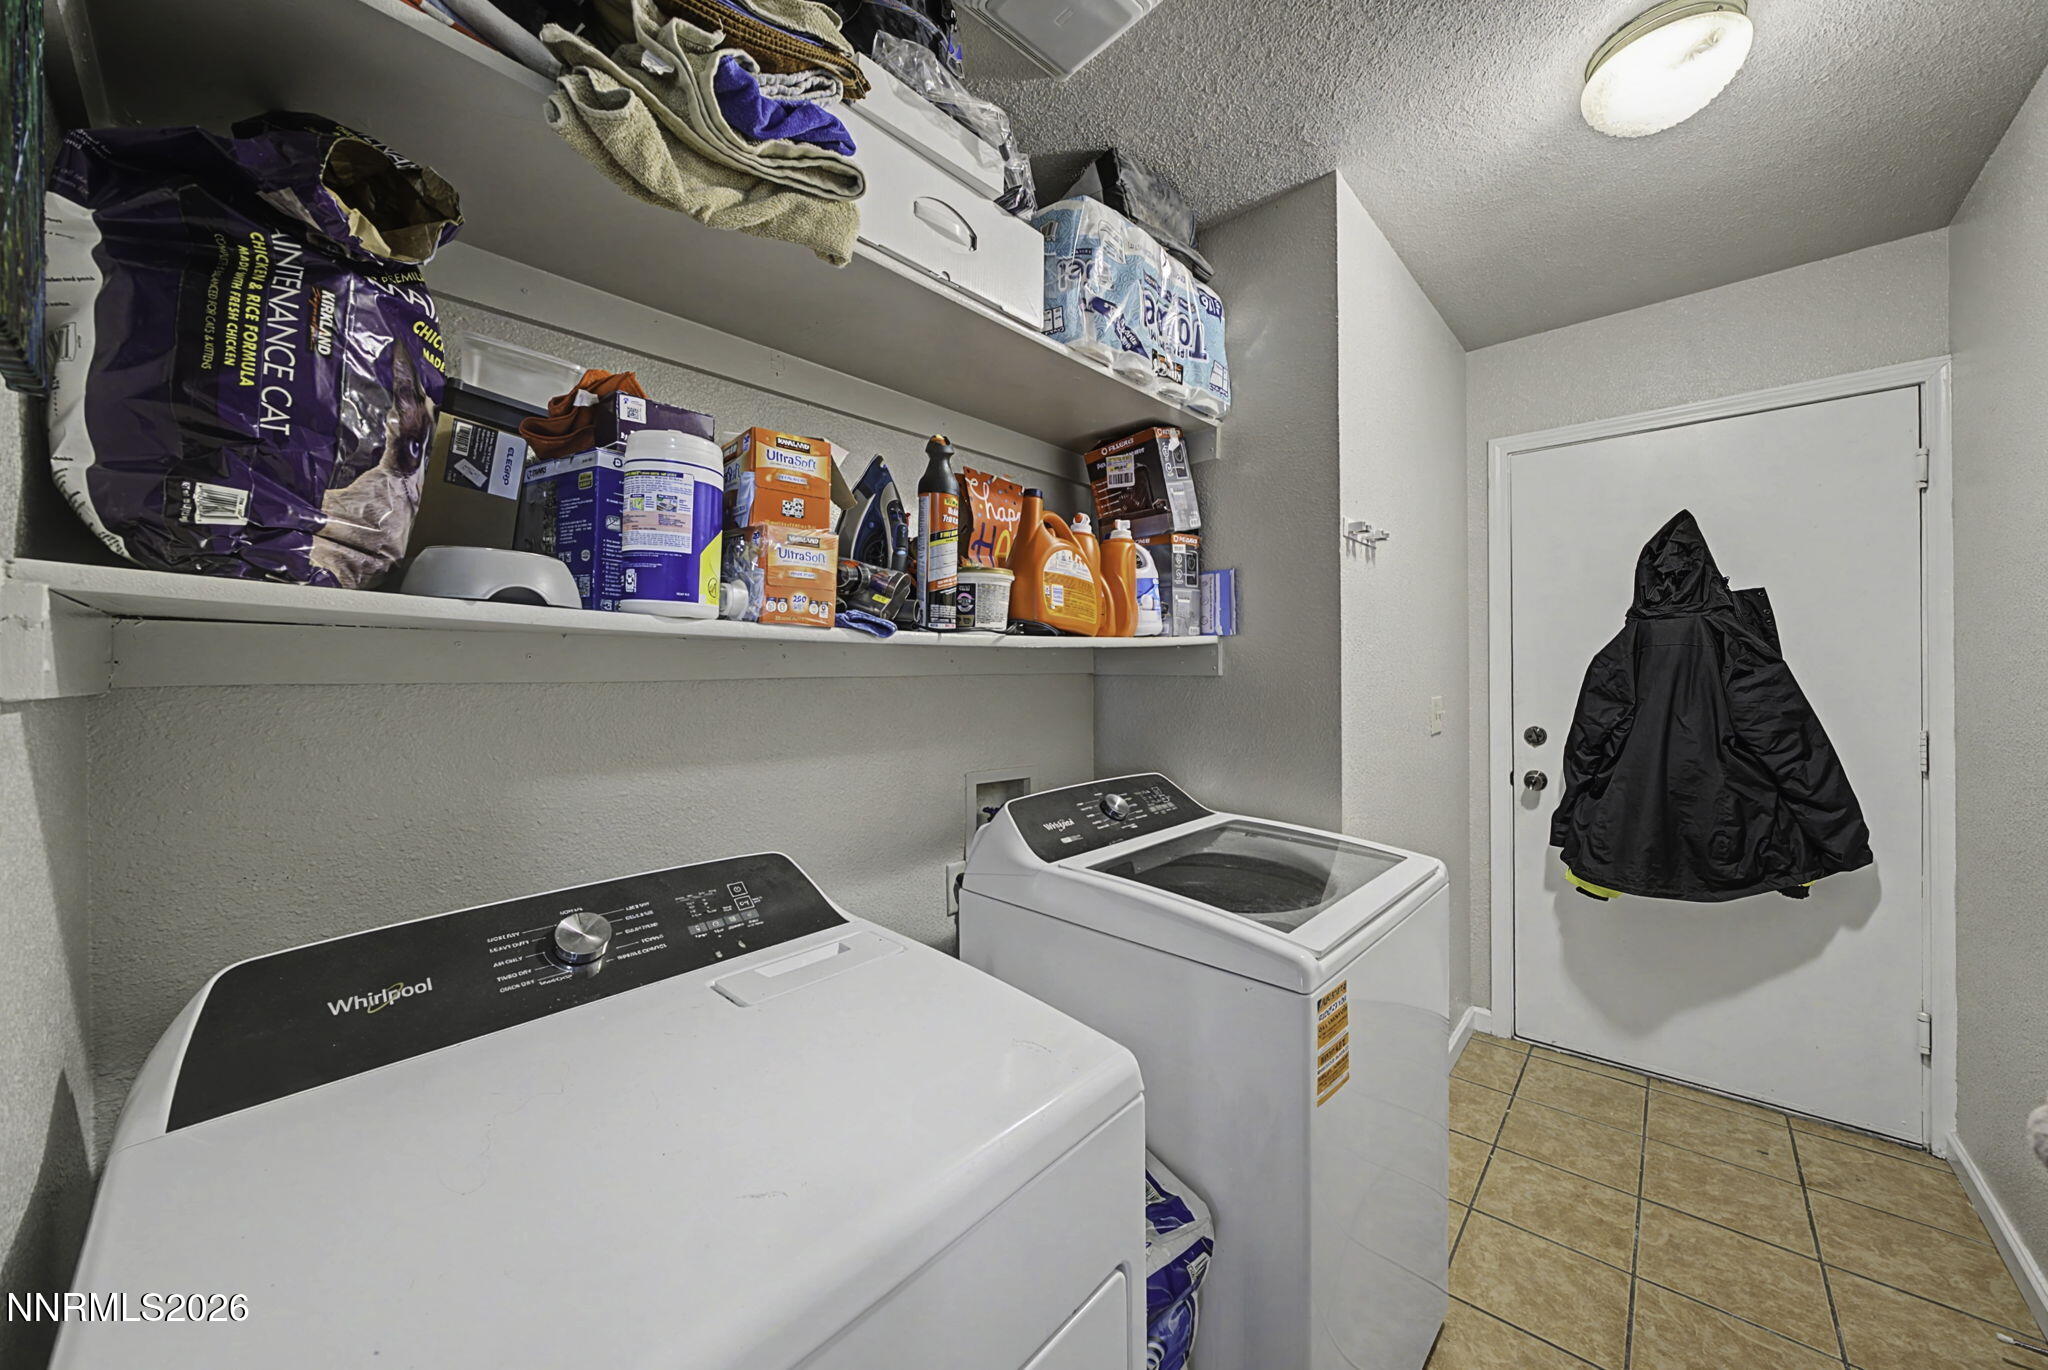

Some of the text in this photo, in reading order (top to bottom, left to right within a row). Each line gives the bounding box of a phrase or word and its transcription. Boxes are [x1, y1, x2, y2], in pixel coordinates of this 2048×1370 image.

[227, 291, 242, 321] FRESH
[239, 231, 269, 386] CHICKEN & RICE FORMULA
[260, 228, 304, 436] AINTENANCE CAT
[318, 289, 336, 355] KIRKLAND
[224, 322, 239, 366] CHICKEN
[326, 977, 433, 1016] Whirlpool
